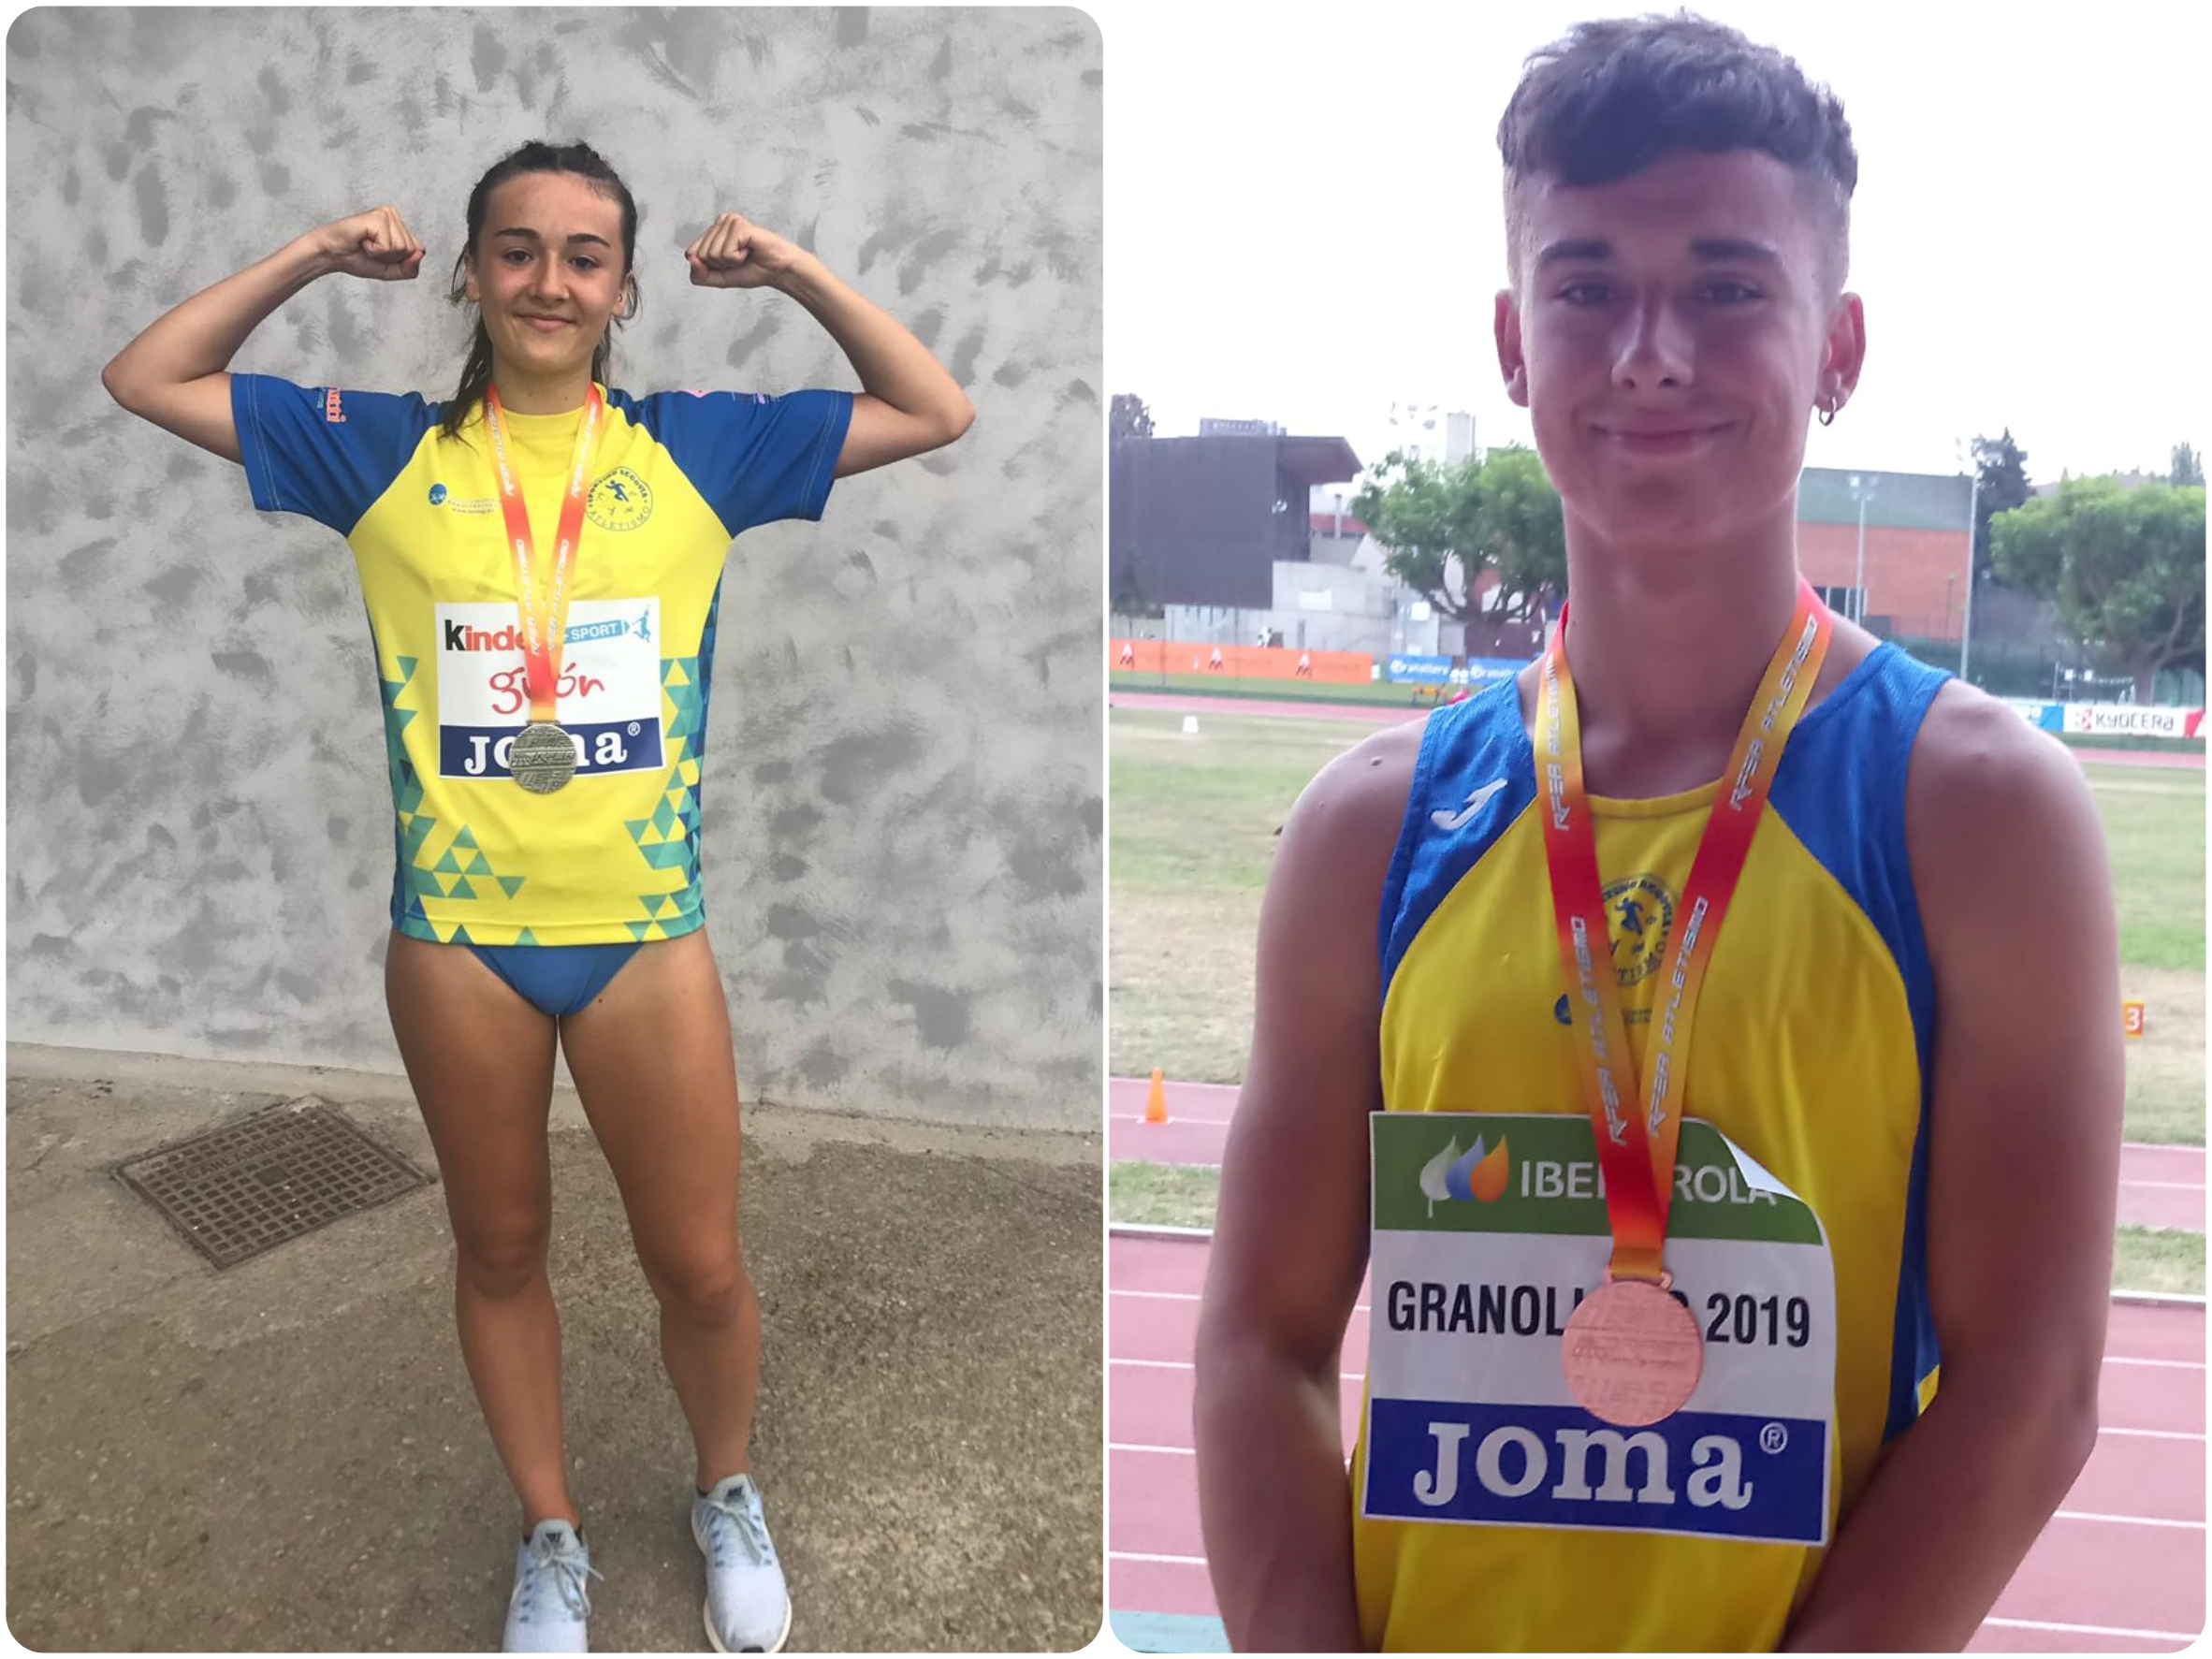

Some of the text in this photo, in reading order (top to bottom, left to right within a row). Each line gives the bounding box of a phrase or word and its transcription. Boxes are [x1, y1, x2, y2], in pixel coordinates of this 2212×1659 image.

[571, 622, 618, 641] SPORT
[2126, 1007, 2140, 1031] 3
[1706, 1293, 1811, 1347] 2019
